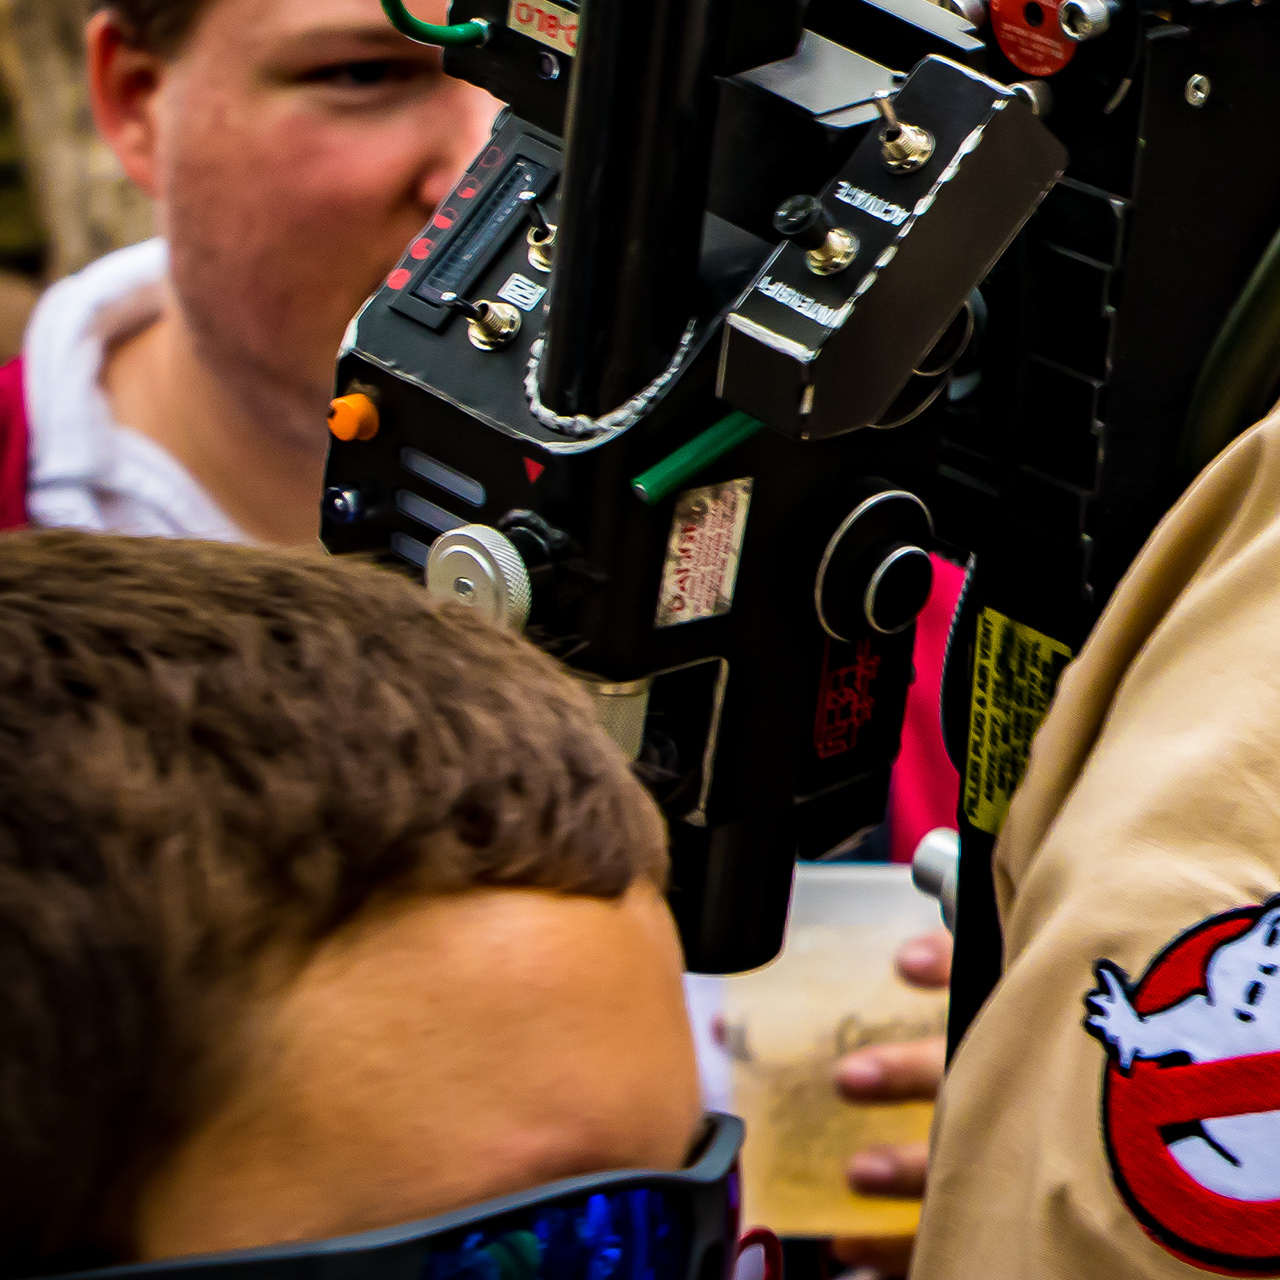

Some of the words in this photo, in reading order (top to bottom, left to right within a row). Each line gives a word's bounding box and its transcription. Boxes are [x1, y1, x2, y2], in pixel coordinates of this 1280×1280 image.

[834, 180, 912, 226] ACTIVATE
[979, 617, 994, 660] VENT
[976, 663, 991, 693] AIR
